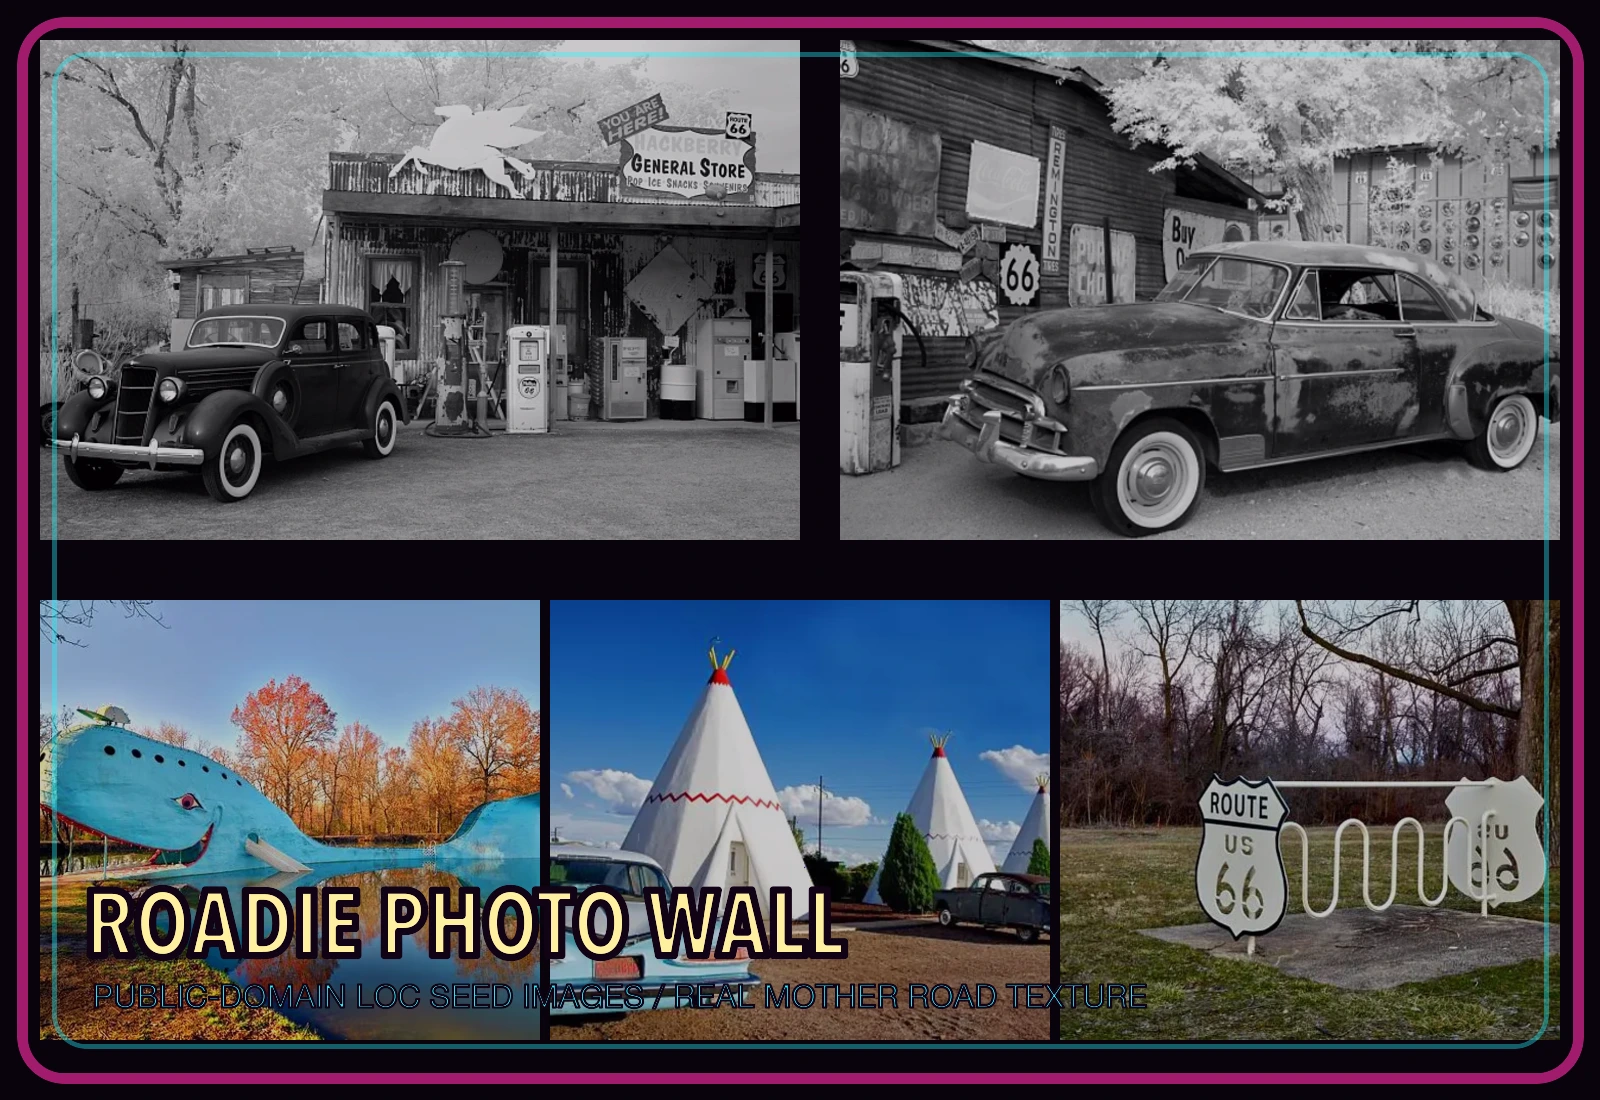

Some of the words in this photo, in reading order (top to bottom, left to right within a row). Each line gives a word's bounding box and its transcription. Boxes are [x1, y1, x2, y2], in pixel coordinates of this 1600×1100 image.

[603, 111, 630, 130] YOU
[635, 97, 660, 117] ARE
[608, 107, 664, 143] HERE!
[729, 116, 748, 124] ROUTE
[729, 123, 747, 135] 66
[1051, 125, 1066, 140] TIRES
[634, 133, 742, 156] HACKBERRY
[631, 153, 696, 176] GENERAL
[700, 157, 745, 179] STORE
[648, 176, 661, 188] ICE
[666, 178, 698, 190] SNACKS
[703, 180, 748, 192] SENIRS
[1047, 141, 1062, 258] REMINGTON
[1006, 257, 1034, 292] 66
[1042, 259, 1060, 272] TIRES
[1210, 791, 1269, 819] ROUTE
[1224, 834, 1254, 856] US
[1215, 861, 1264, 920] 66
